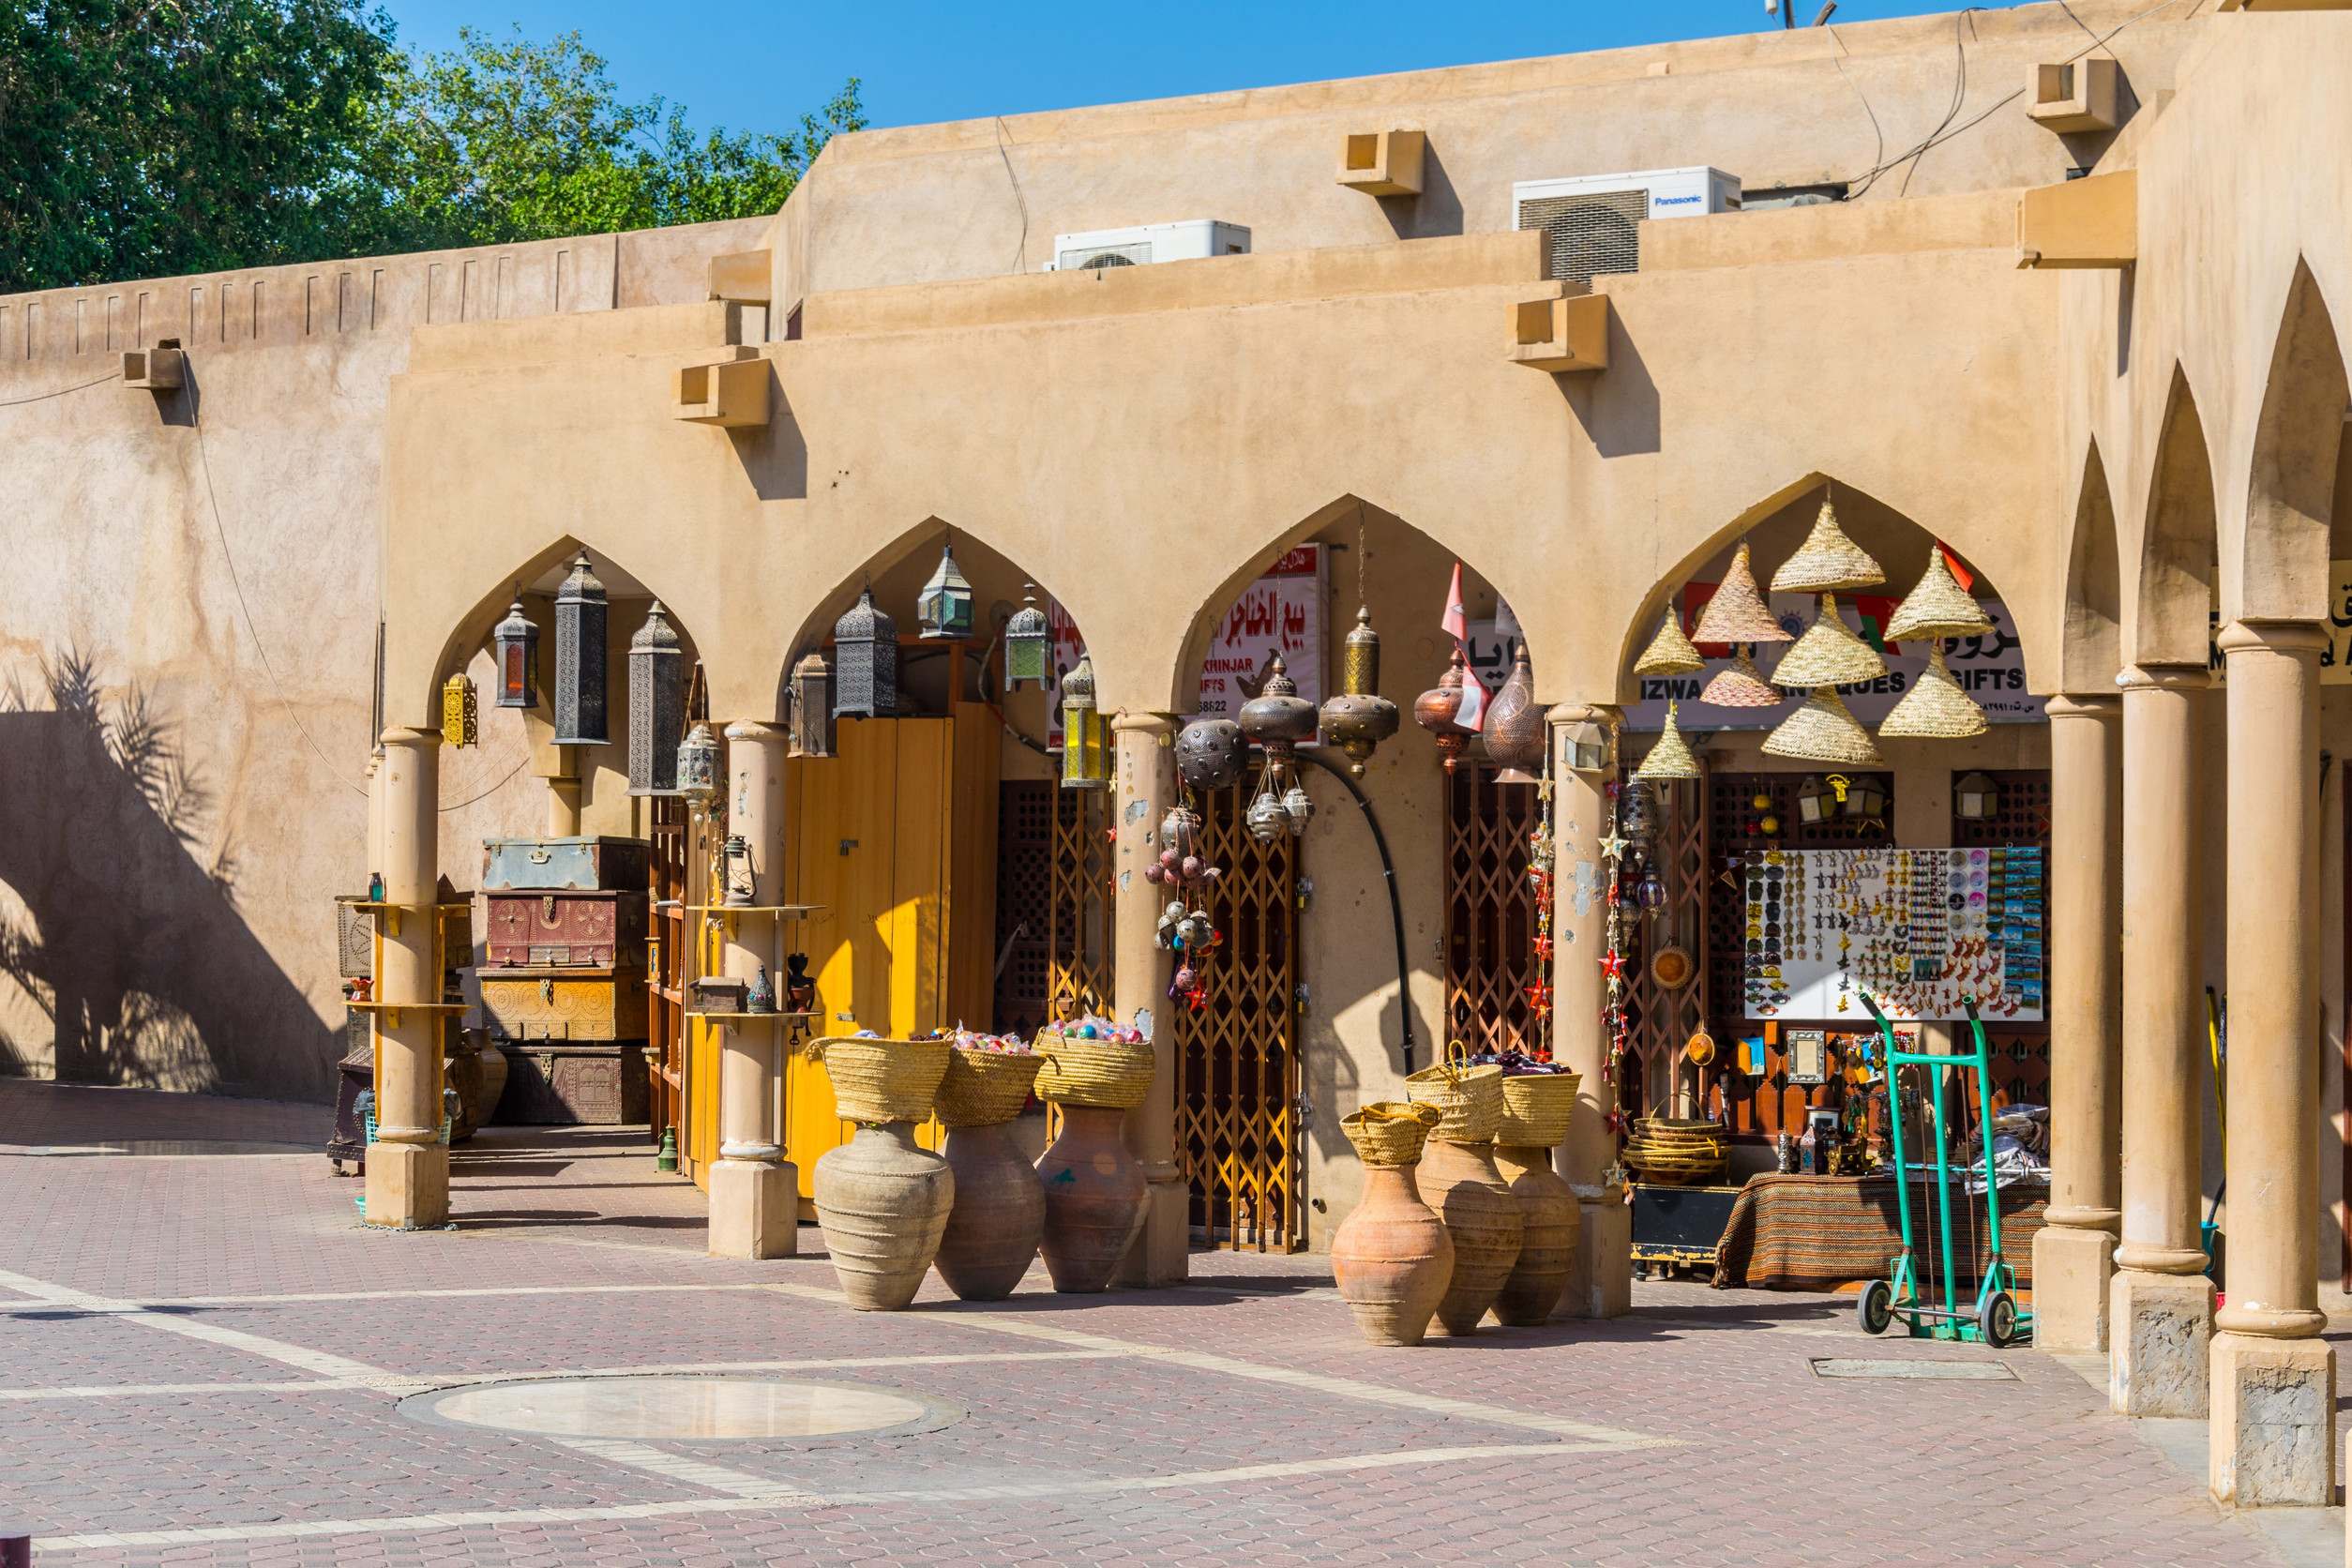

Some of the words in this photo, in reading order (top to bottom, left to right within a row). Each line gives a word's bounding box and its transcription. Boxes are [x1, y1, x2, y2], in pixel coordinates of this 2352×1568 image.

[1655, 195, 1702, 206] Panasonic
[1200, 678, 1225, 693] IFTS
[1641, 679, 1702, 701] IZWA
